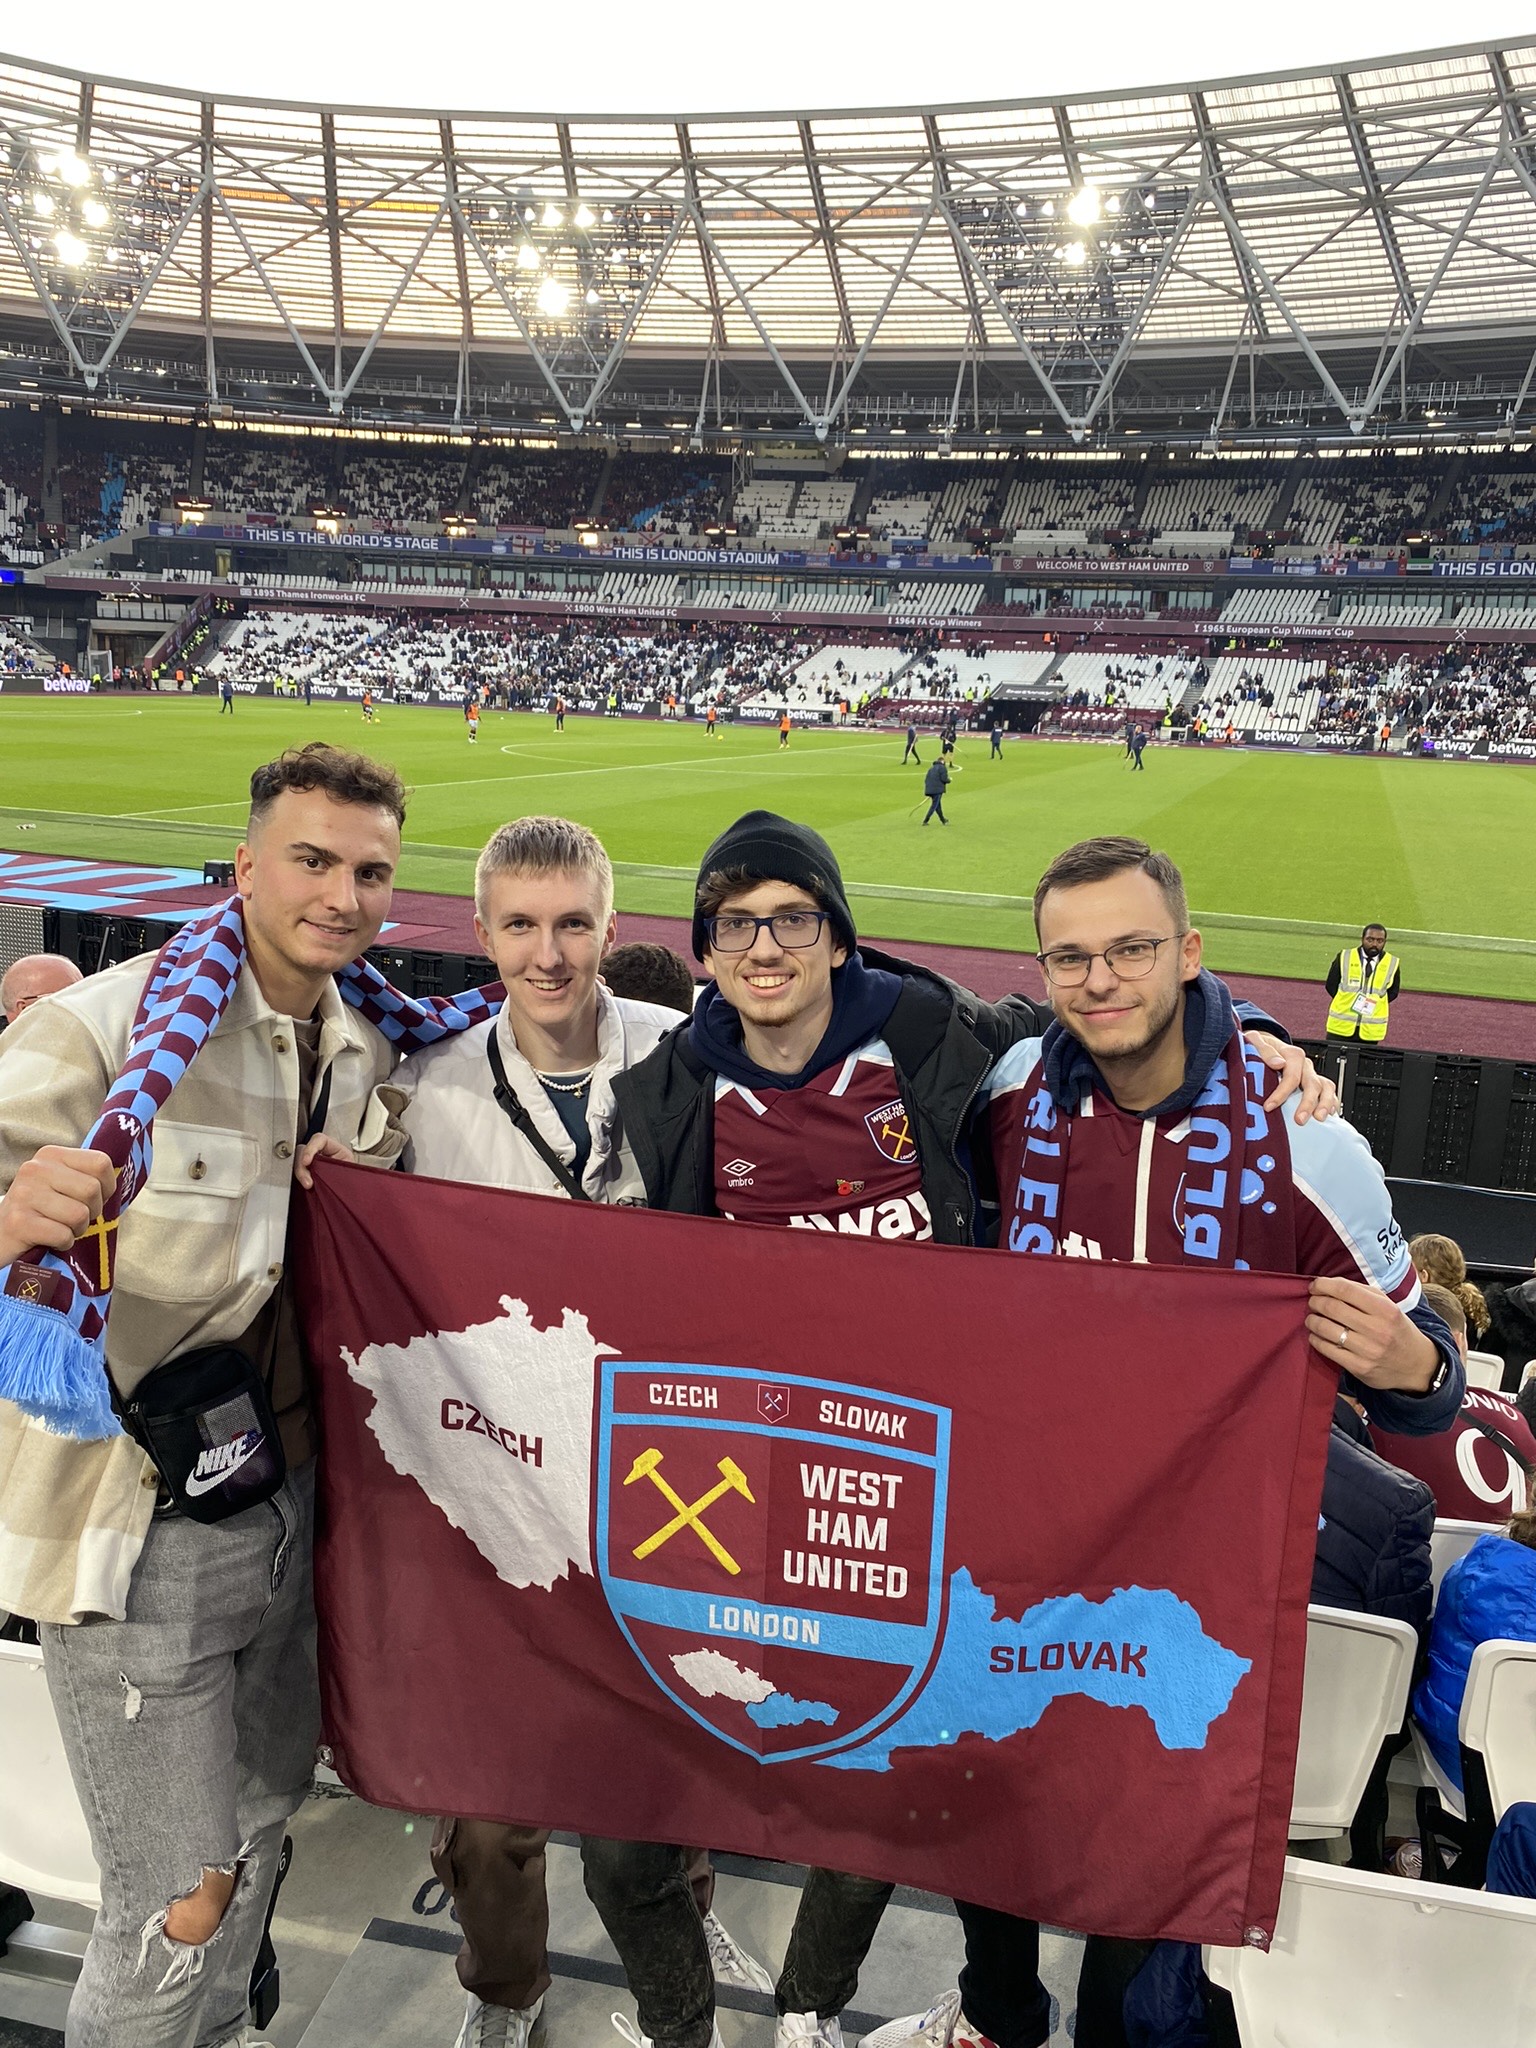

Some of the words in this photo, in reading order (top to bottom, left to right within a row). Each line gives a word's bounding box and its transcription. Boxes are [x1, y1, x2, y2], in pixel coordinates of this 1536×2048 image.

[246, 528, 279, 541] THIS
[282, 530, 295, 542] IS
[300, 531, 326, 544] THE
[329, 533, 392, 548] WORLD'S
[394, 537, 439, 550] STAGE
[613, 547, 644, 559] THIS
[646, 549, 659, 559] IS
[661, 549, 717, 563] LONDON
[718, 552, 779, 565] STADIUM
[1036, 561, 1083, 570] WELCOME
[1085, 562, 1099, 570] TO
[1100, 562, 1127, 571] WEST
[1128, 562, 1151, 571] HAM
[1152, 562, 1189, 571] UNITED
[1439, 563, 1476, 576] THIS
[1480, 563, 1496, 576] IS
[1499, 563, 1536, 576] LON
[253, 588, 275, 597] 1895
[276, 589, 309, 599] Thames
[310, 591, 353, 602] Ironworks
[354, 593, 366, 602] FC
[574, 604, 595, 613] 1900
[596, 605, 616, 614] West
[617, 606, 637, 615] Ham
[638, 607, 665, 617] United
[666, 608, 677, 617] FC
[895, 616, 915, 626] 1964
[917, 617, 928, 626] FA
[928, 617, 946, 628] Cup
[947, 618, 982, 627] Winners
[1202, 624, 1224, 633] 1965
[1226, 625, 1271, 635] European
[1272, 626, 1291, 636] Cup
[1292, 627, 1334, 637] Winners'
[1334, 628, 1354, 638] Cup
[43, 678, 92, 693] betway
[1005, 688, 1054, 696] betway
[740, 707, 777, 721] betway
[787, 708, 819, 720] betwa
[1255, 730, 1302, 745] betway
[1434, 740, 1476, 755] etway
[871, 1107, 891, 1123] WEST
[881, 1108, 906, 1124] UNITED
[728, 1177, 754, 1188] umbro
[648, 1383, 719, 1410] CZECH
[819, 1400, 908, 1440] SLOVAK
[440, 1397, 544, 1469] CZECH
[195, 1433, 248, 1477] NIKE
[1455, 1427, 1527, 1514] 9
[800, 1462, 903, 1509] WEST
[806, 1509, 889, 1552] HAM
[782, 1549, 909, 1600] UNITED
[708, 1603, 821, 1646] LONDON
[989, 1641, 1148, 1678] SLOVAK
